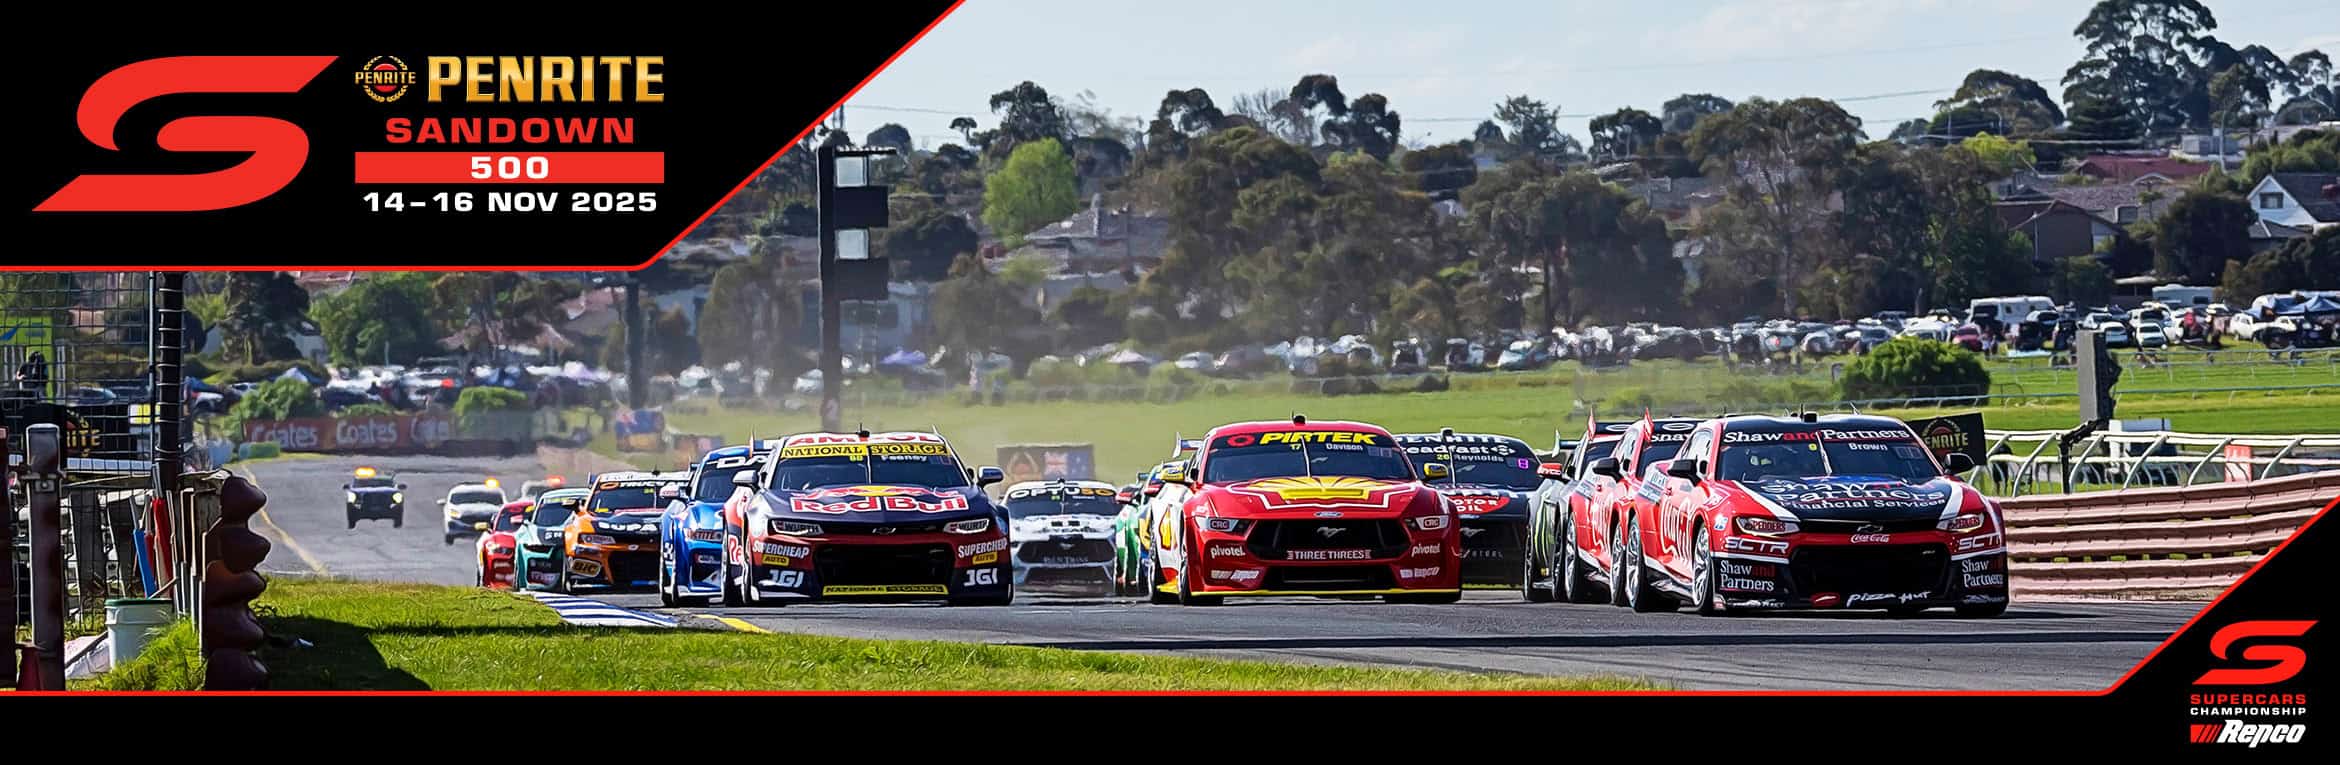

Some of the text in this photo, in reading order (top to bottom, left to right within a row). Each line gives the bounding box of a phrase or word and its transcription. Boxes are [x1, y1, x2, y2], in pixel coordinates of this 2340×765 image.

[336, 419, 398, 444] Coates
[1259, 431, 1376, 445] PIRTEK
[1823, 429, 1911, 440] Partners
[784, 444, 946, 456] NATIONAL STORAGE
[1849, 442, 1888, 451] Brown
[791, 495, 969, 513] Red Bull
[1454, 498, 1499, 506] OTOR
[1874, 498, 1946, 509] Services
[752, 540, 810, 559] SUPERCHEAP
[958, 538, 1008, 558] SUPERCHEAP
[764, 556, 787, 564] AUTO
[1295, 550, 1365, 560] THREE THREES
[963, 568, 998, 586] JGI
[1720, 573, 1775, 591] Partners
